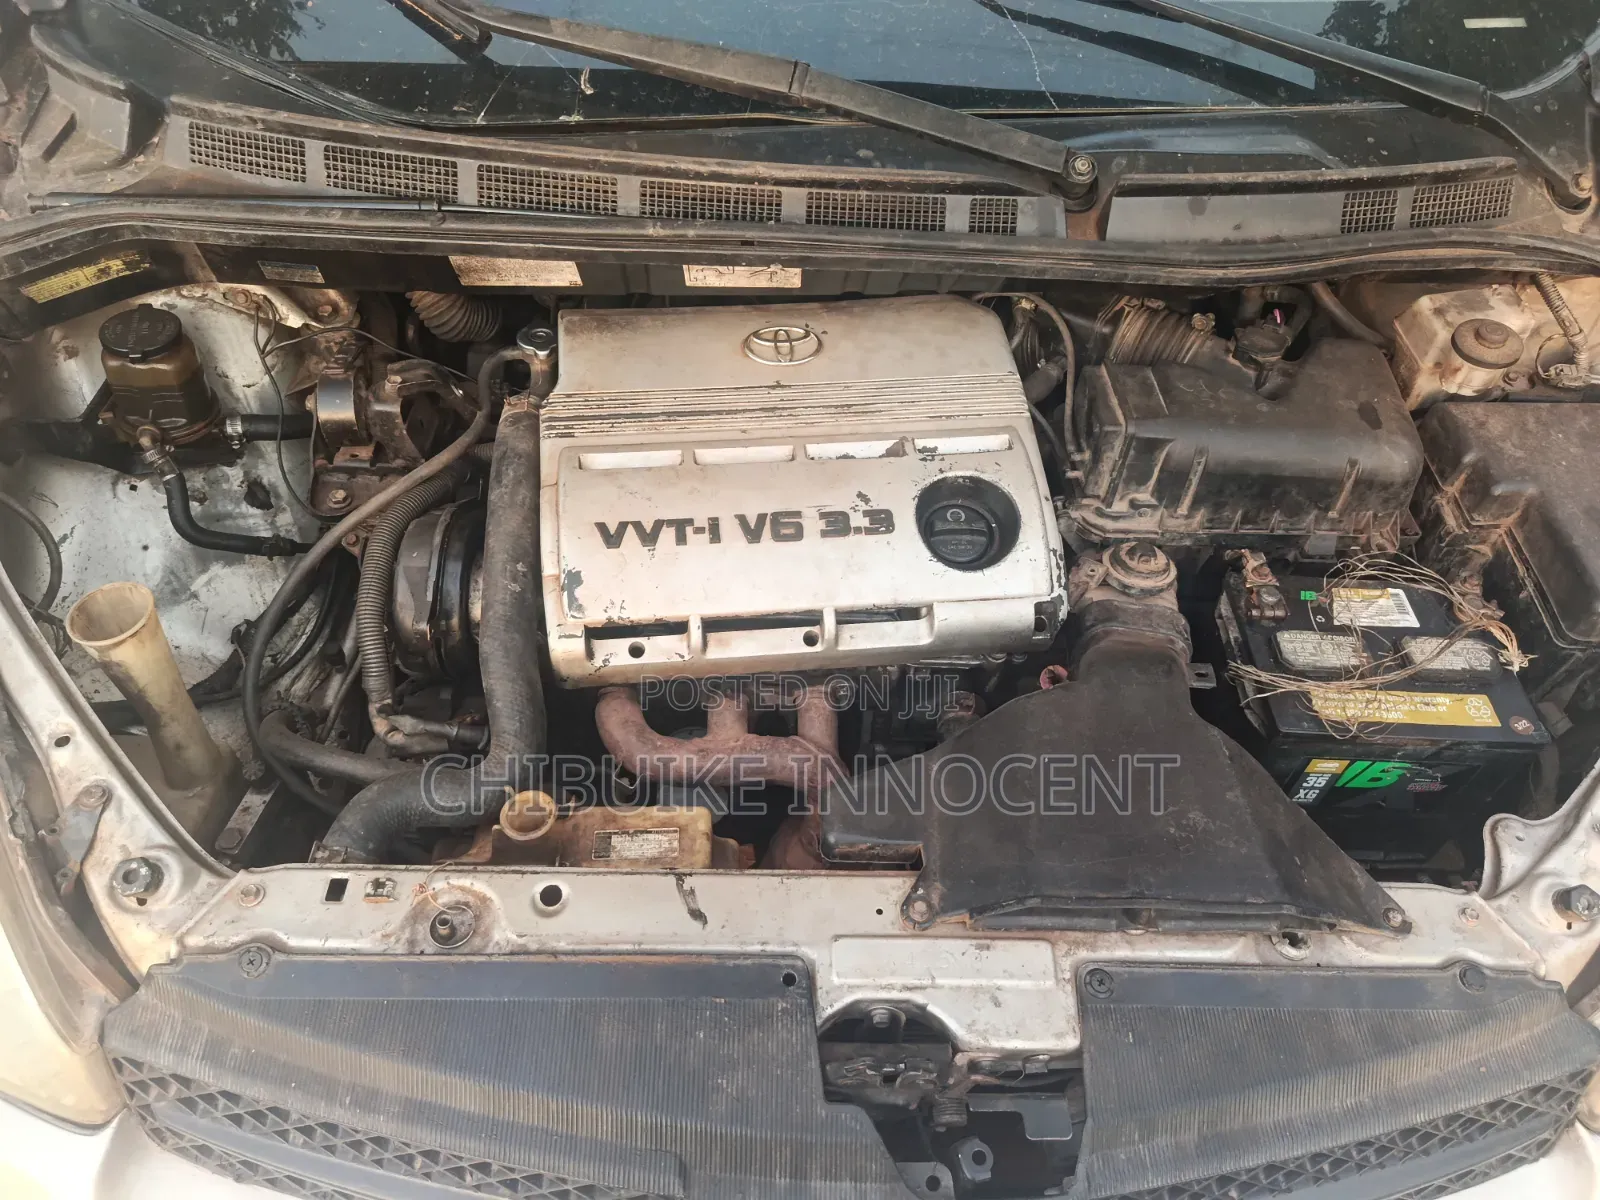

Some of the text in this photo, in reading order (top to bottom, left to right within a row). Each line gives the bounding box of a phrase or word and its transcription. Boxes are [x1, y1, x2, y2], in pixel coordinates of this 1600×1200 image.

[734, 511, 804, 544] V6
[818, 508, 895, 538] 3.3
[1514, 719, 1530, 730] 3/22
[1302, 776, 1330, 788] 35
[1294, 789, 1320, 799] XG
